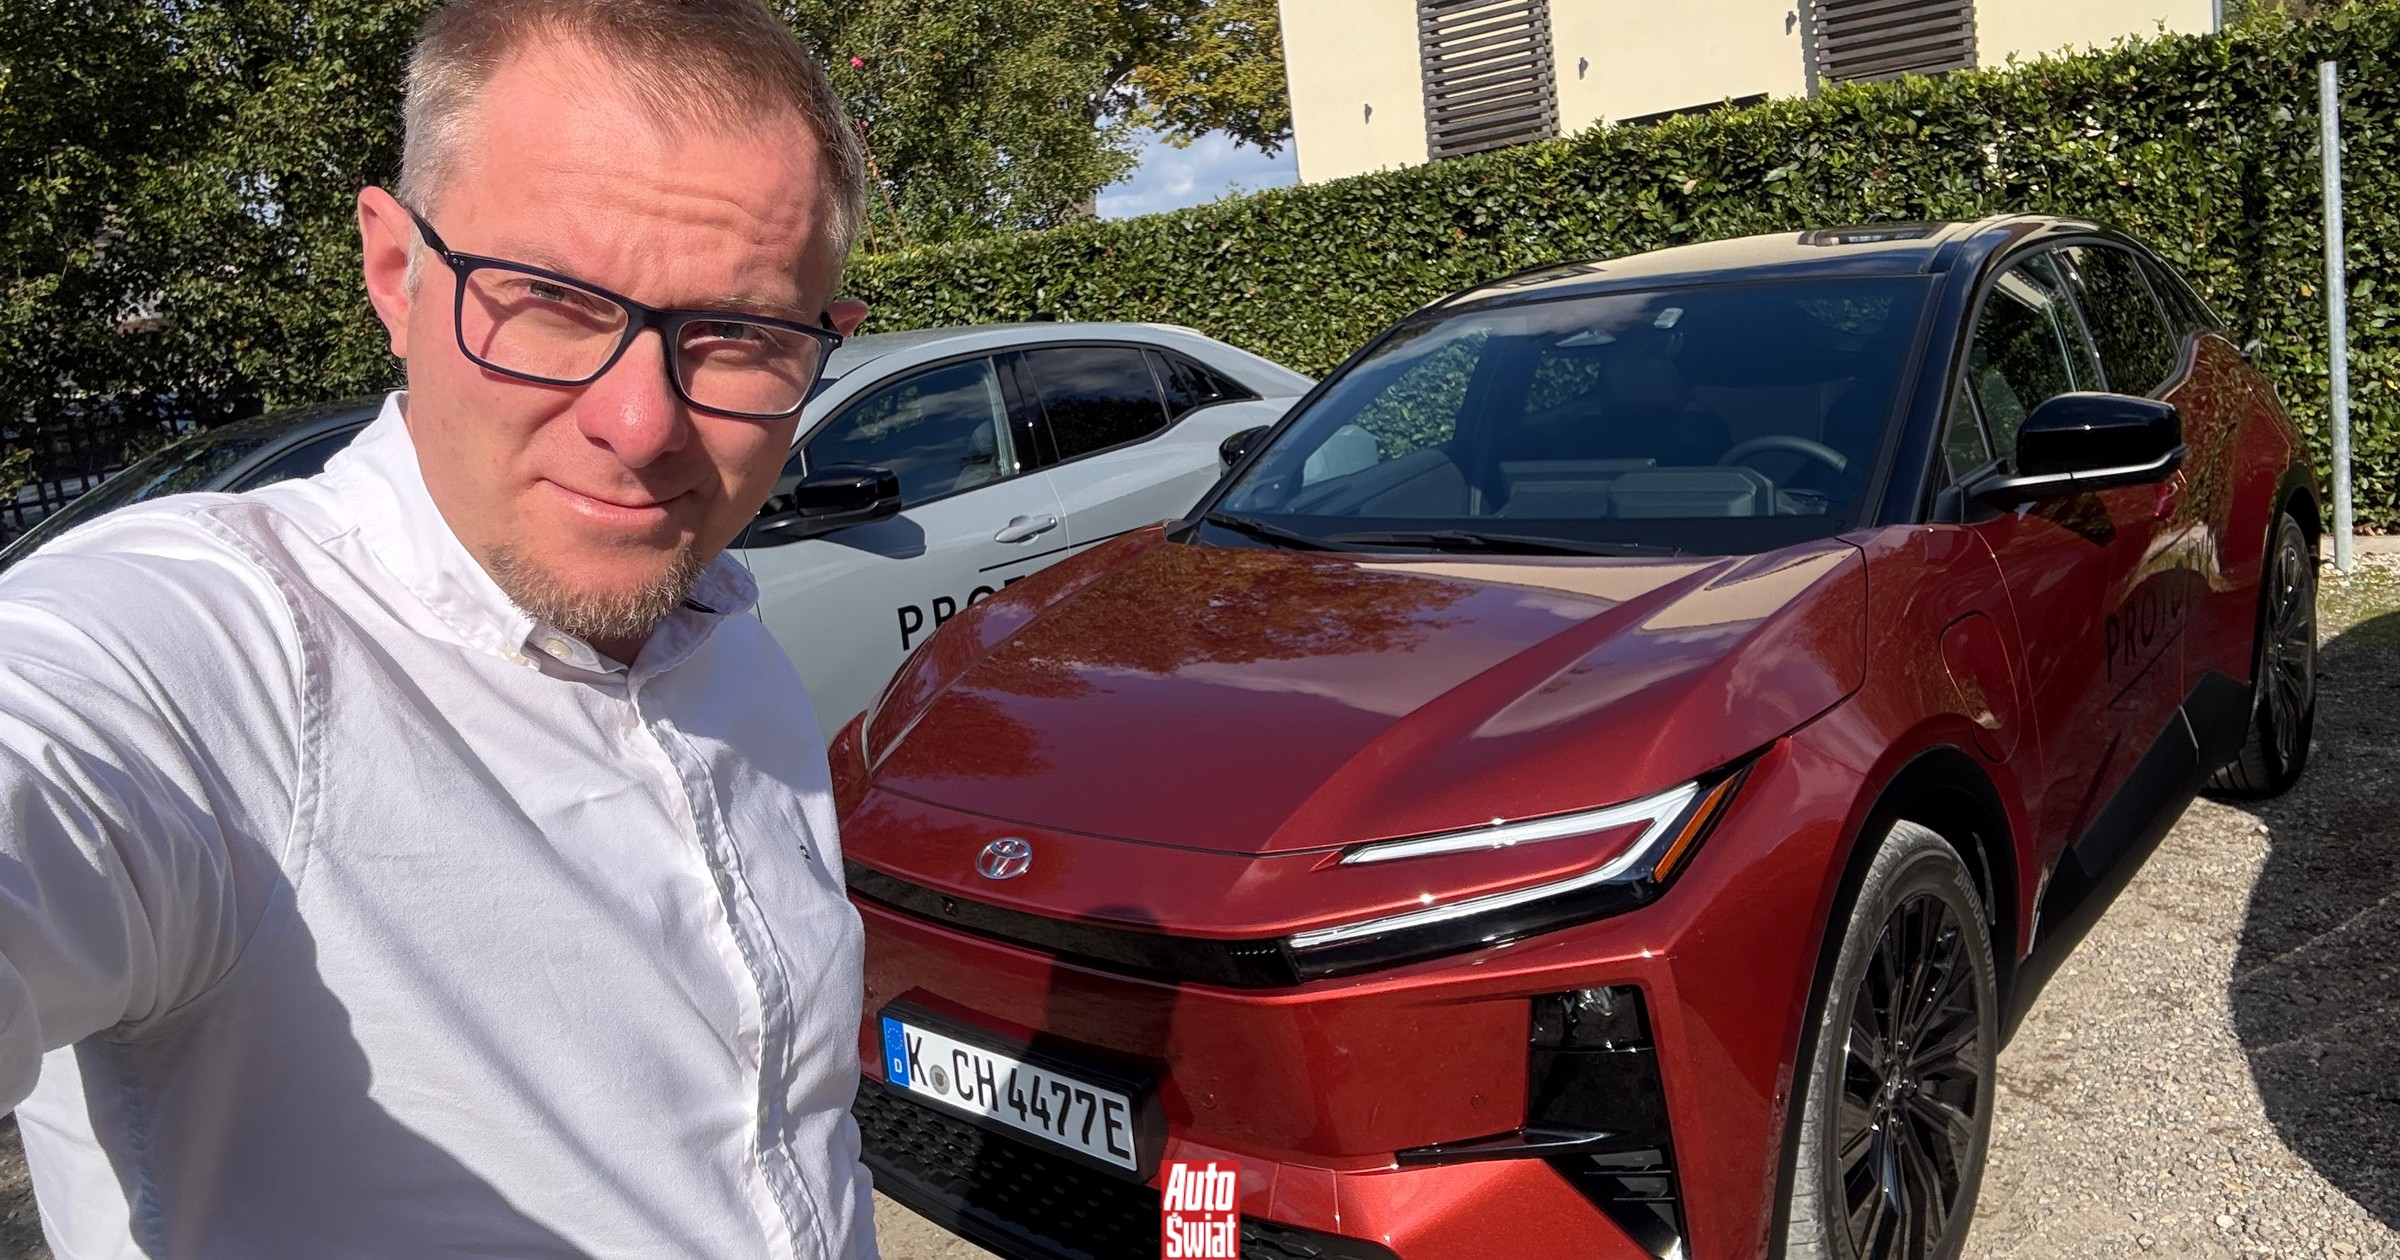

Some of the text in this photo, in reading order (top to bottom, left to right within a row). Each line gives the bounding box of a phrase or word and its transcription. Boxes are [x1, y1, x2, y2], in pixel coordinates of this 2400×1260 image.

[905, 1031, 1131, 1161] K CH 4477E
